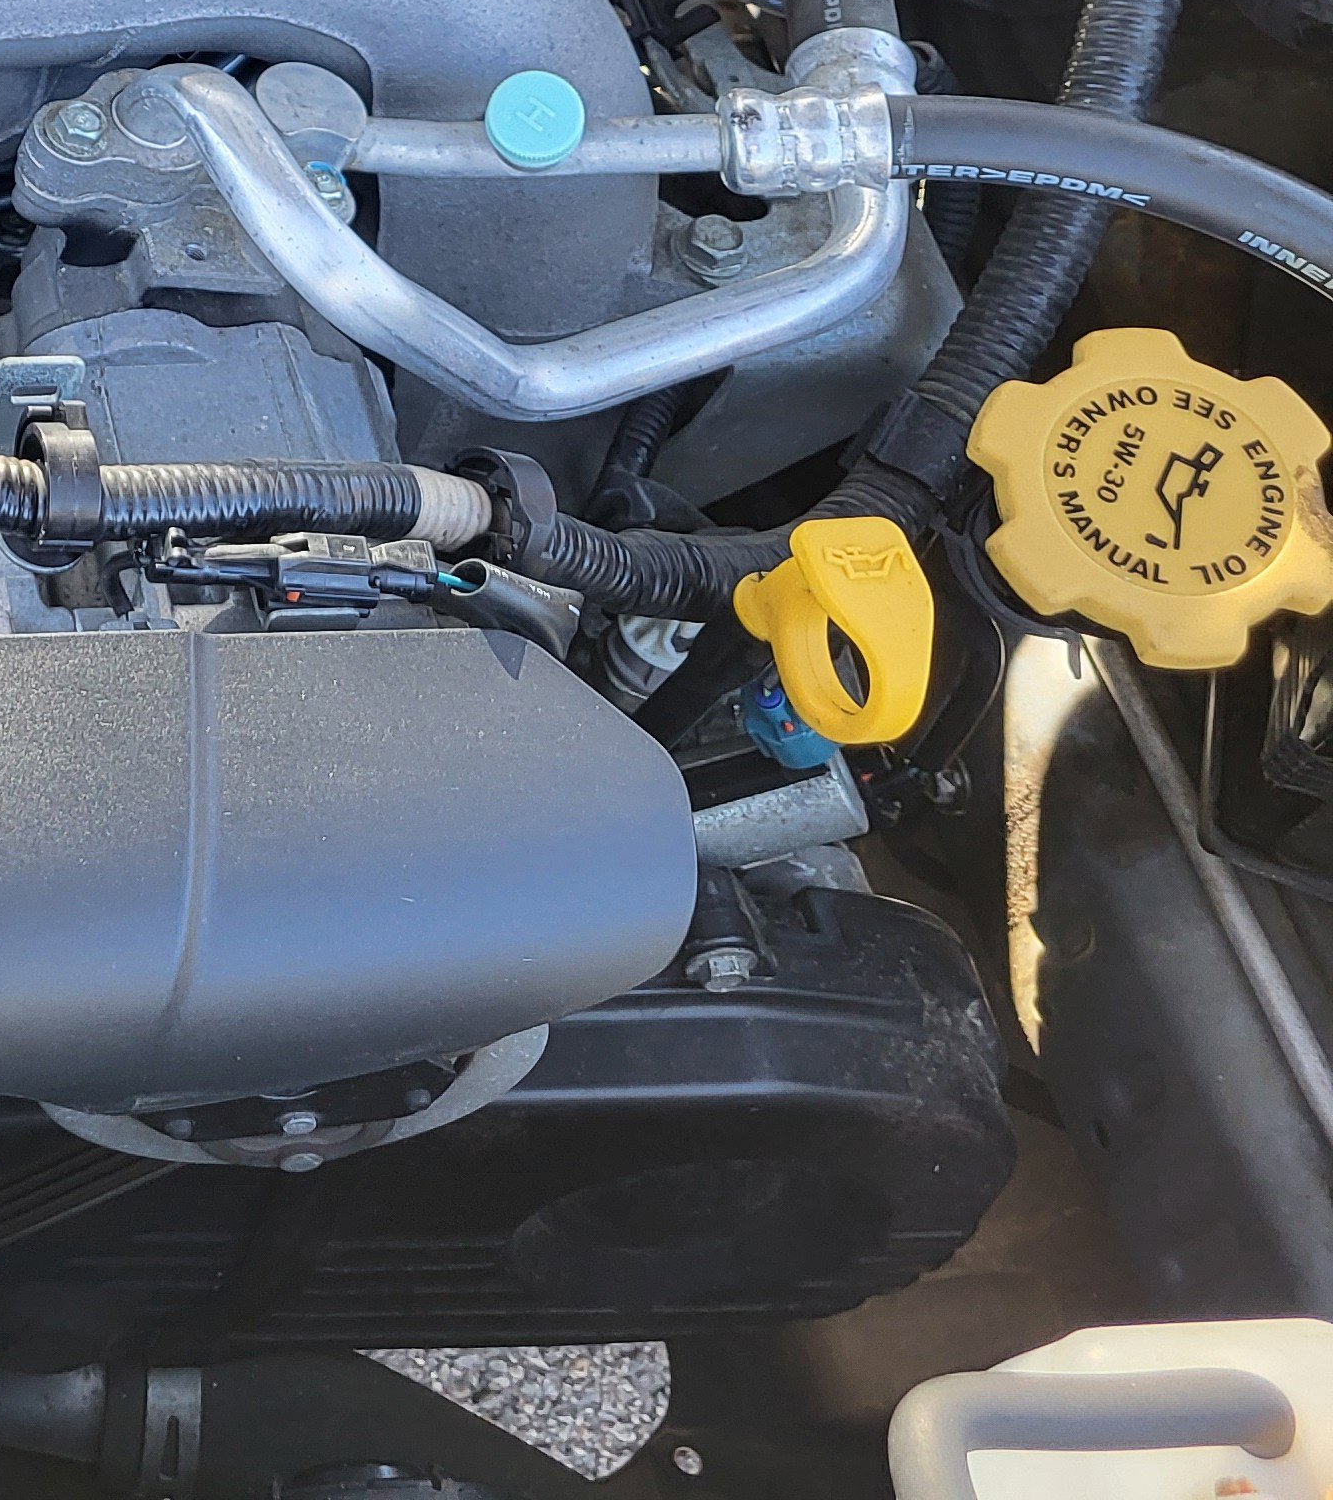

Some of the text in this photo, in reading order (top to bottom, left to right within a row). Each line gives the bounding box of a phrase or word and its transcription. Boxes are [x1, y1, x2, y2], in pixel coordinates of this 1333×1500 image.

[515, 96, 554, 131] H
[891, 163, 1152, 208] TER>EPDM<
[1053, 386, 1237, 585] SEE OWNER'S MANUAL
[1096, 422, 1146, 504] 5W-30
[1189, 439, 1285, 585] ENGINE OIL
